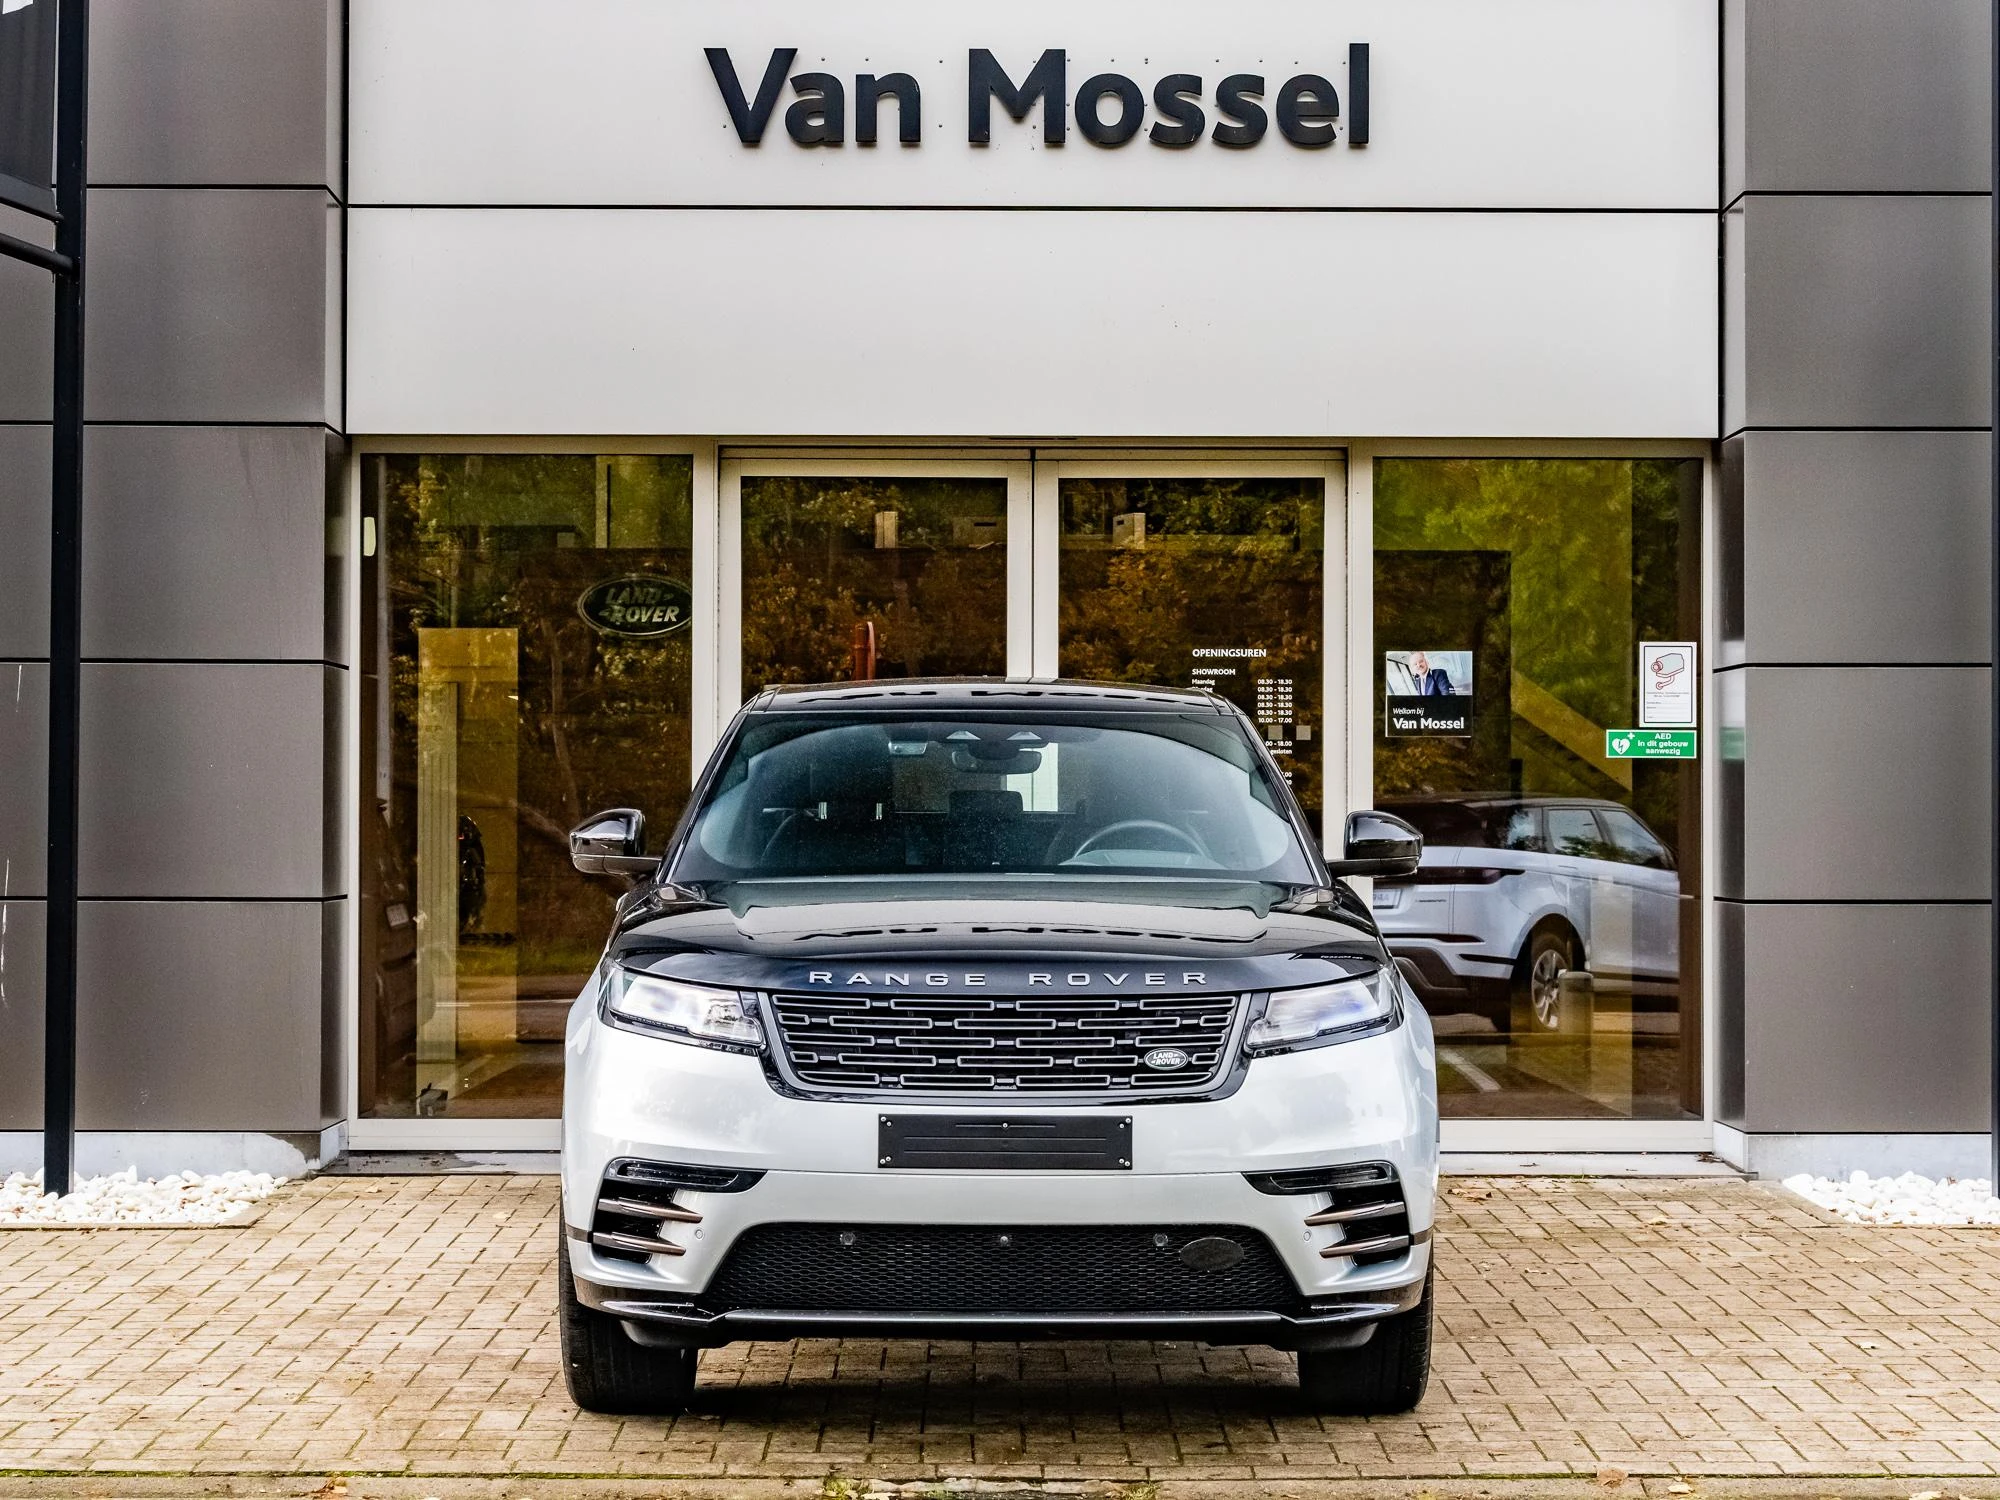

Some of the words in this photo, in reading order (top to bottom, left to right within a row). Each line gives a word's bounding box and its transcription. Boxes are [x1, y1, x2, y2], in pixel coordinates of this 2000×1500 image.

[703, 47, 921, 145] Van
[968, 42, 1370, 148] Mossel
[606, 587, 661, 605] LAND
[609, 605, 680, 623] ROVER
[1192, 648, 1267, 658] OPENINGSUREN
[1191, 668, 1236, 676] SHOWROOM
[1192, 678, 1215, 686] Maandag
[1392, 707, 1416, 715] Welkom
[1416, 707, 1425, 717] bij
[1392, 717, 1417, 729] Van
[1420, 717, 1465, 729] Mossel
[1654, 732, 1672, 740] AED
[1646, 739, 1657, 747] dit
[1658, 740, 1689, 749] gebouw
[1645, 747, 1681, 756] aanwezig
[809, 970, 986, 987] RANGE
[1028, 971, 1207, 987] ROVER
[1153, 1051, 1174, 1059] LAND
